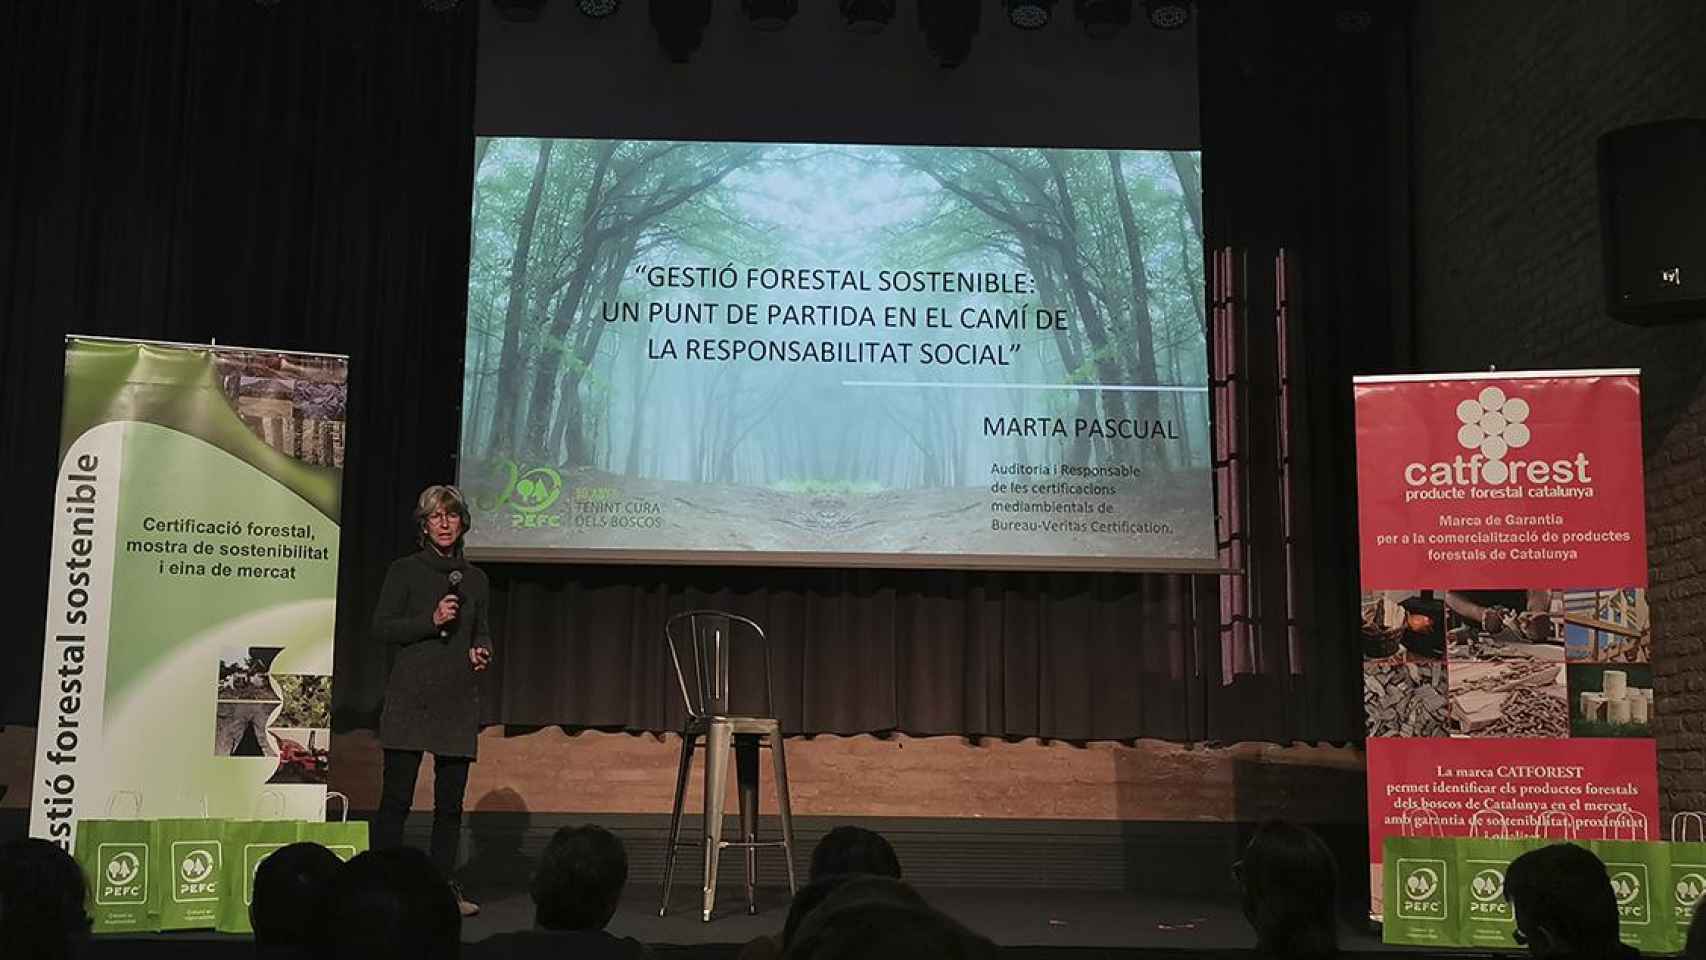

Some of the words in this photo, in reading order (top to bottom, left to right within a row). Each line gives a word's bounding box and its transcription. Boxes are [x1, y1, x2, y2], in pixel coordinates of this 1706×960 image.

[747, 267, 871, 292] FORESTAL
[878, 270, 1036, 295] SOSTENIBLE:
[602, 302, 639, 324] UN
[648, 303, 718, 325] PUNT
[727, 304, 758, 326] DE
[767, 305, 875, 328] PARTIDA
[885, 307, 917, 328] EN
[927, 307, 952, 329] EL
[959, 303, 1029, 330] CAMÍ
[1037, 308, 1067, 331] DE
[648, 339, 677, 360] LA
[686, 339, 913, 365] RESPONSABILITAT
[984, 417, 1067, 438] MARTA
[1075, 418, 1179, 440] PASCUAL
[991, 463, 1050, 476] Auditoria
[1061, 464, 1141, 478] Responsable
[1404, 453, 1592, 485] catforest
[991, 482, 1007, 494] de
[1010, 482, 1029, 494] les
[1032, 483, 1116, 496] certificacions
[1406, 487, 1465, 502] producte
[1471, 486, 1523, 499] forestal
[1528, 486, 1594, 500] catalunya
[625, 503, 661, 514] CURA
[991, 501, 1094, 514] mediambientals
[1097, 502, 1113, 514] de
[512, 514, 560, 528] PEFC
[611, 516, 661, 528] BOSCOS
[992, 519, 1088, 532] Bureau-Veritas
[1091, 520, 1173, 535] Certification.
[1439, 514, 1481, 526] Marca
[1485, 514, 1501, 526] de
[1505, 513, 1563, 526] Garantia
[143, 516, 241, 536] Certificació
[247, 521, 315, 541] forestal,
[66, 453, 98, 625] sostenible
[1376, 534, 1399, 546] per
[1402, 535, 1409, 544] a
[1413, 532, 1425, 544] la
[1428, 531, 1538, 544] comercialització
[1542, 531, 1558, 543] de
[1562, 530, 1631, 546] productes
[126, 538, 187, 554] mostra
[193, 540, 215, 555] de
[219, 541, 329, 561] sostenibilitat
[1428, 548, 1487, 560] forestals
[1490, 548, 1506, 560] de
[1510, 548, 1578, 561] Catalunya
[159, 560, 164, 574] i
[169, 560, 205, 576] eina
[211, 561, 233, 577] de
[237, 563, 296, 580] mercat
[47, 635, 86, 764] forestal
[1437, 765, 1453, 778] La
[1456, 768, 1494, 778] marca
[1496, 766, 1584, 779] CATFOREST
[1386, 783, 1430, 796] permet
[1432, 782, 1496, 794] identificar
[1500, 782, 1517, 794] els
[1519, 783, 1582, 796] productes
[1585, 783, 1639, 796] forestals
[1393, 797, 1418, 809] dels
[1421, 797, 1462, 810] boscos
[1465, 798, 1480, 810] de
[1484, 798, 1547, 813] Catalunya
[1551, 801, 1564, 811] en
[1568, 799, 1580, 811] el
[44, 774, 75, 855] stió
[104, 886, 139, 897] PEFC
[180, 882, 216, 894] PEFC
[1404, 900, 1439, 912] PEFC
[1471, 901, 1505, 913] PEFC
